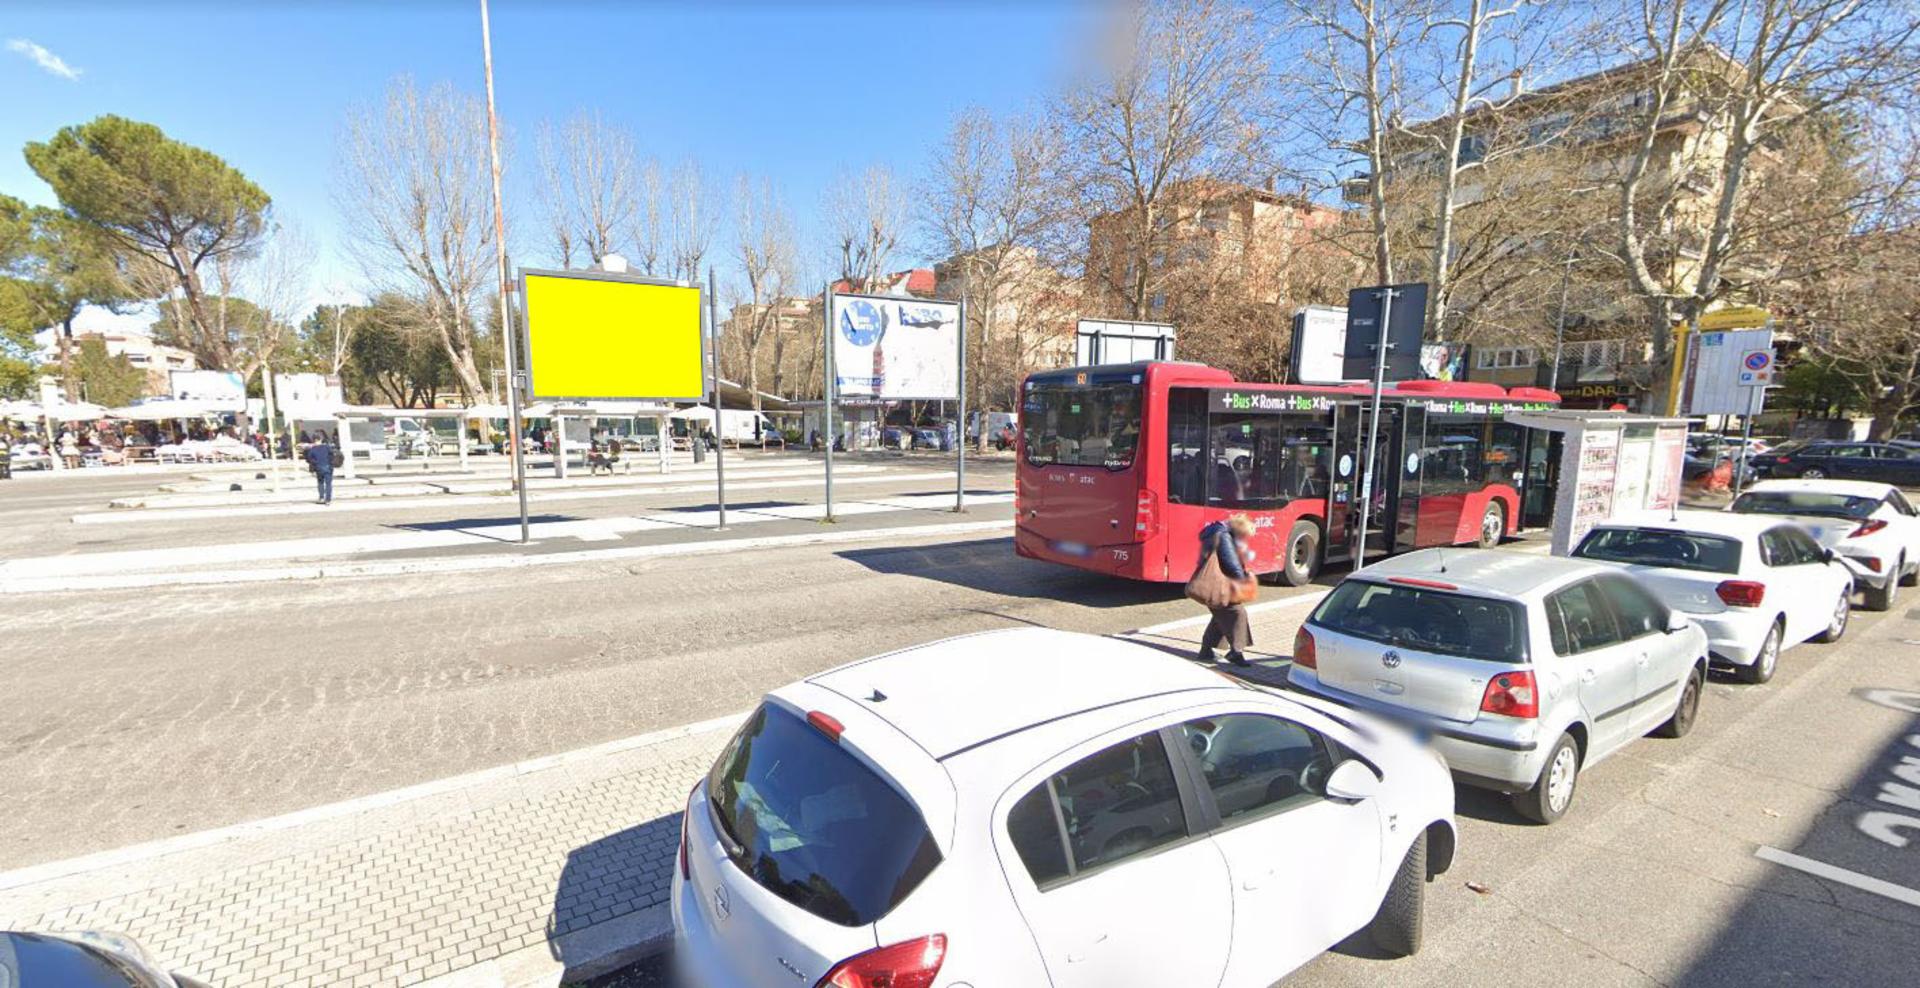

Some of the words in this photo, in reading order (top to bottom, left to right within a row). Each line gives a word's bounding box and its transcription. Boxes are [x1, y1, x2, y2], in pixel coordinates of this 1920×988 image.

[1260, 394, 1286, 410] Roma
[1255, 516, 1275, 528] atac
[1113, 550, 1129, 561] 775
